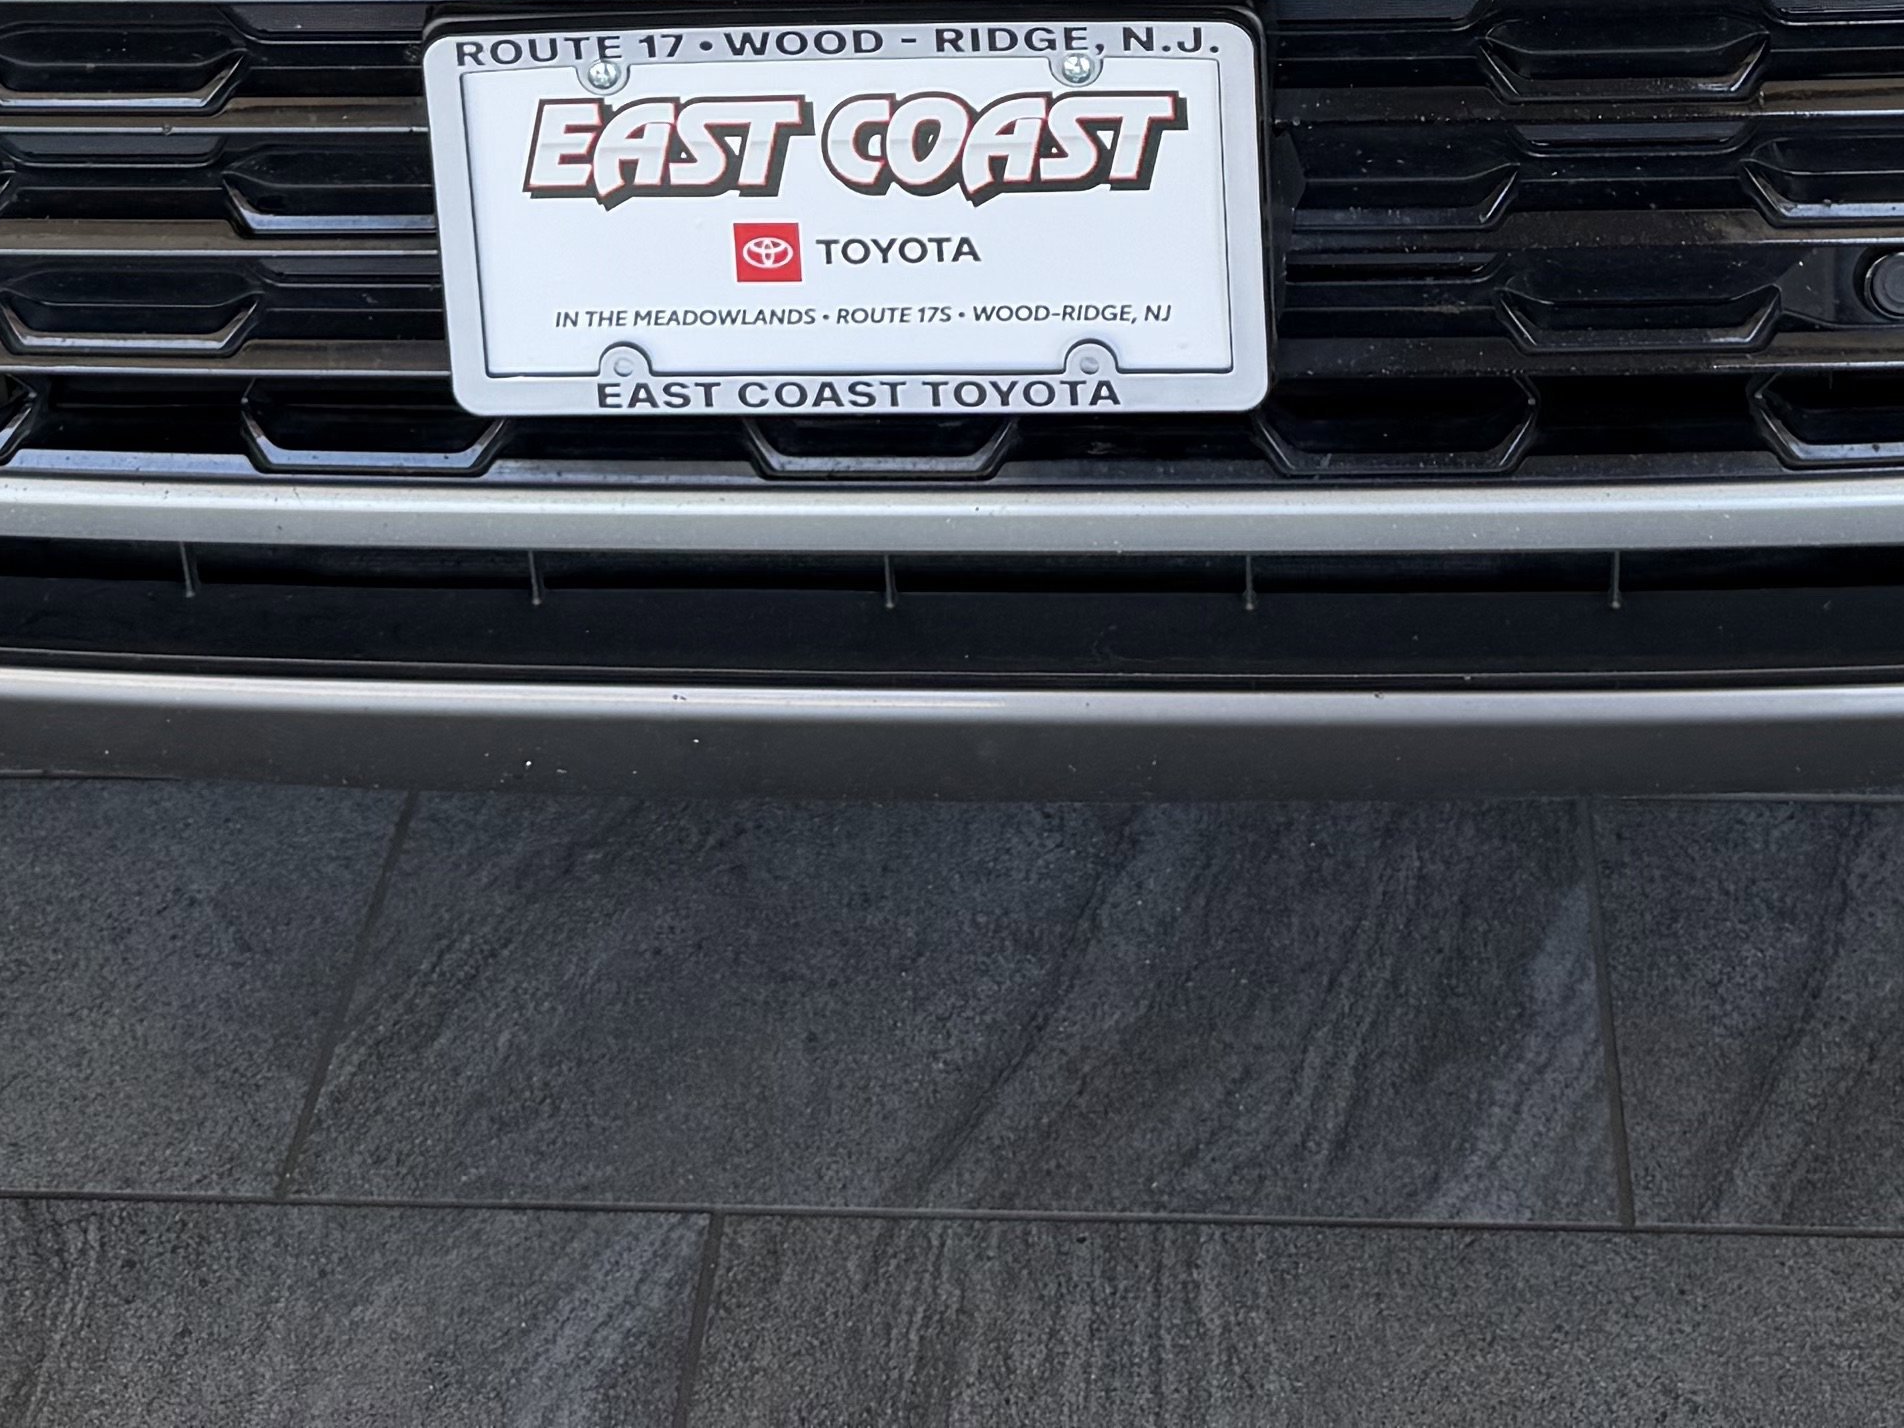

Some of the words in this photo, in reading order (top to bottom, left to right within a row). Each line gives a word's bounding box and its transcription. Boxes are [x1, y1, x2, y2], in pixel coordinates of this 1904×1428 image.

[456, 35, 623, 67] ROUTE
[638, 34, 683, 58] 17
[723, 29, 884, 56] WOOD
[934, 26, 1105, 56] RIDGE,
[1122, 26, 1220, 54] N.J.
[523, 94, 816, 211] EAST
[821, 91, 1189, 207] COAST
[814, 236, 982, 265] TOYOTA
[555, 310, 579, 328] IN
[585, 310, 627, 328] THE
[633, 307, 817, 327] MEADOWLANDS
[836, 306, 912, 324] ROUTE
[918, 306, 952, 323] 17S
[973, 304, 1138, 325] WOOD-RIDGE,
[1144, 304, 1172, 323] NJ
[597, 381, 721, 409] EAST
[738, 380, 907, 409] COAST
[922, 379, 1122, 407] TOYOTA
